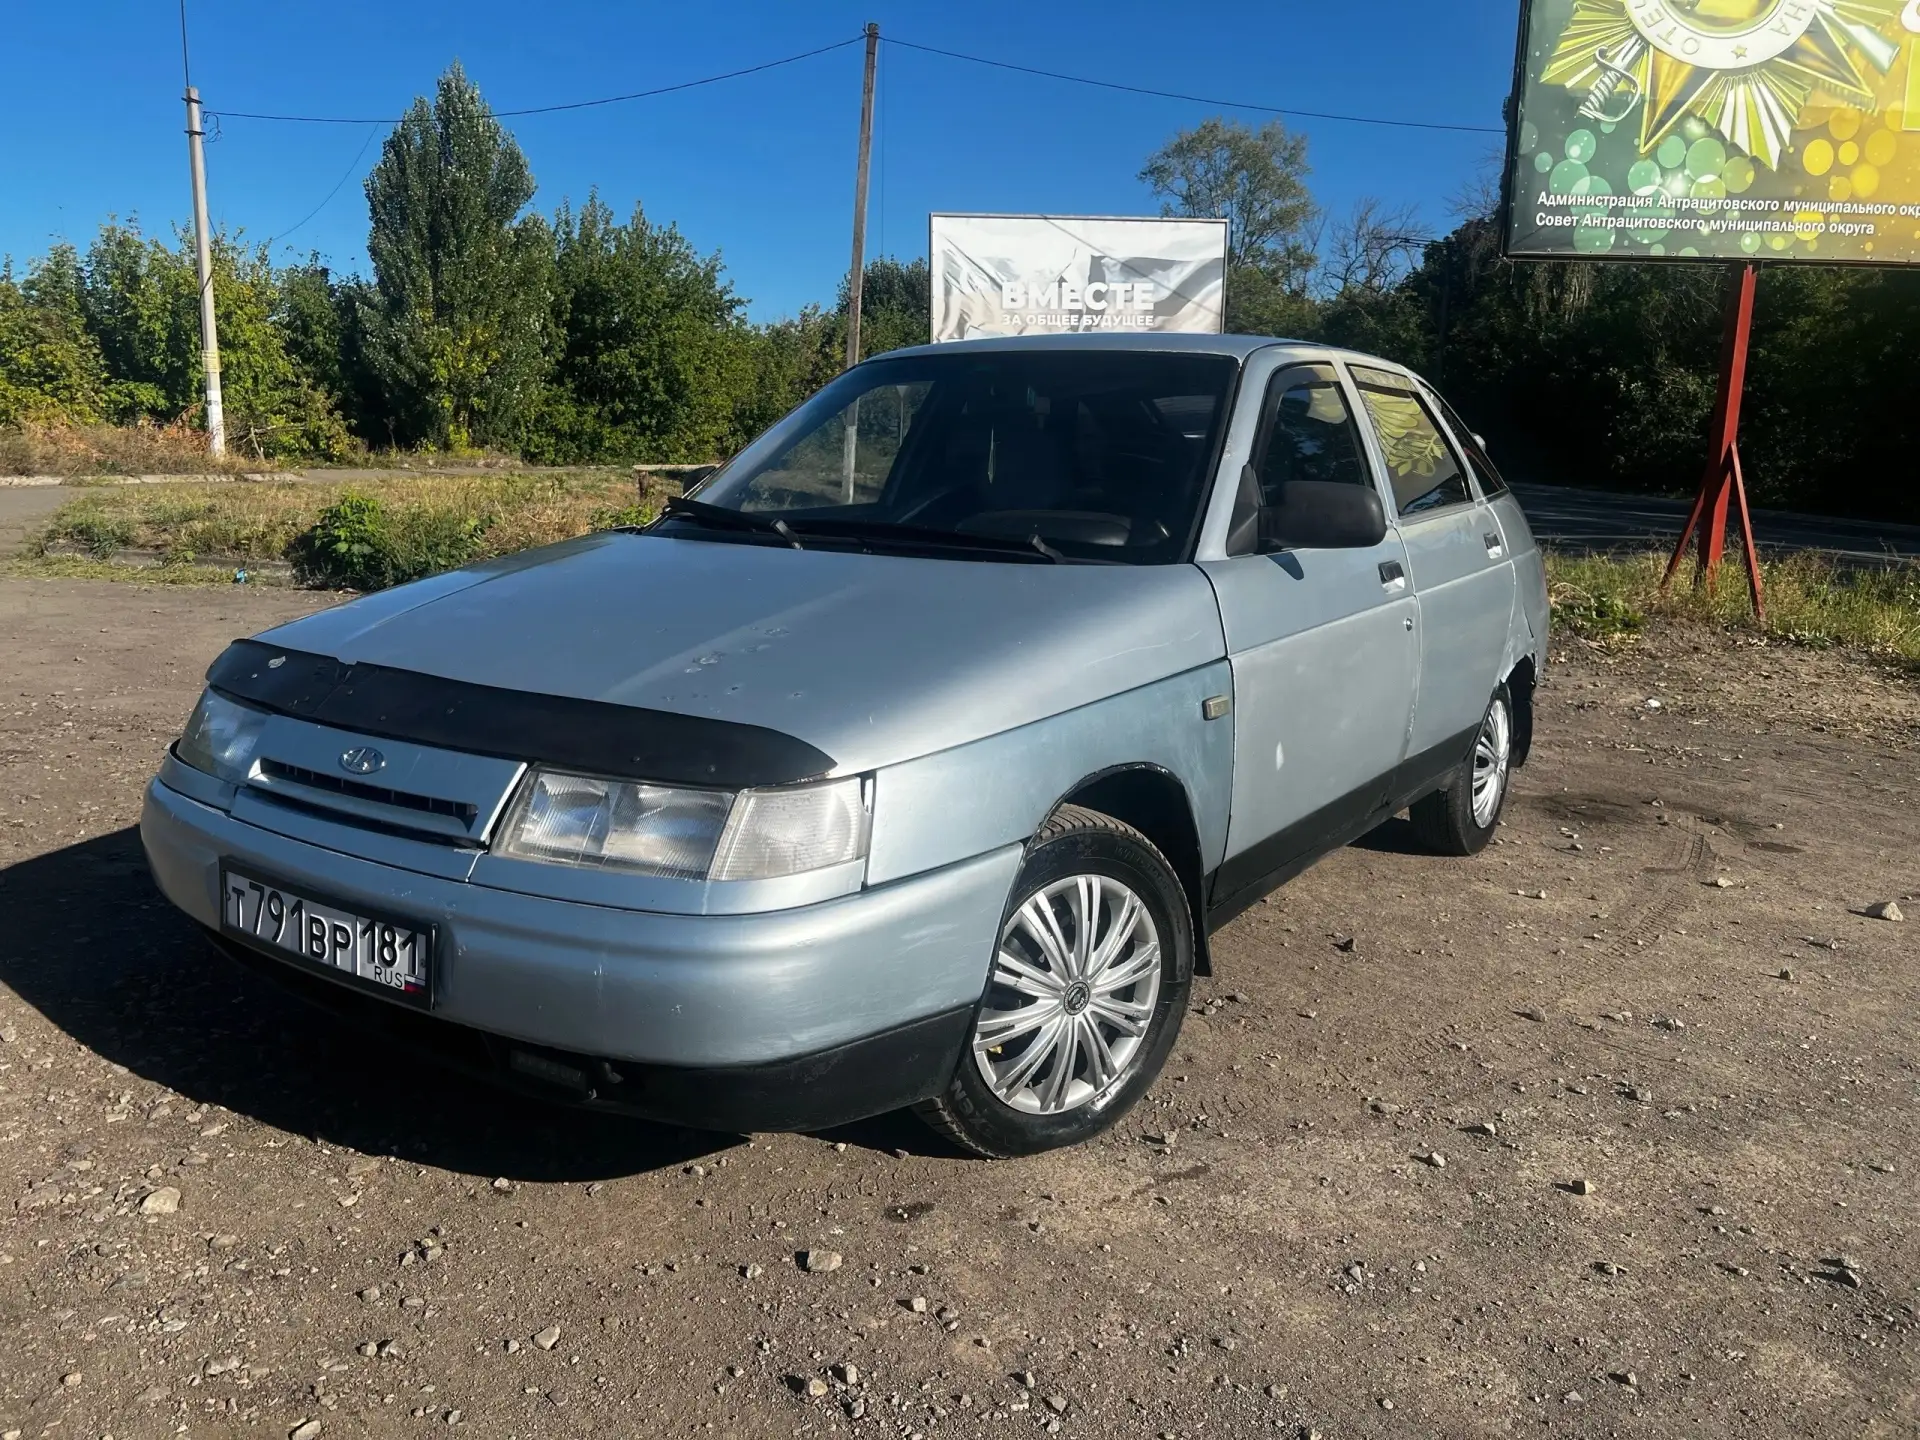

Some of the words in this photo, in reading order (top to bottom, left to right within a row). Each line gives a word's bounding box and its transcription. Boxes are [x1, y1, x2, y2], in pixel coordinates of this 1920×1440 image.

[1537, 191, 1653, 209] Администрация
[1657, 193, 1780, 211] Антрацитовского
[1783, 200, 1896, 216] муниципального
[1535, 212, 1579, 227] Совет
[1581, 213, 1705, 230] Антрацитовского
[1709, 218, 1825, 233] муниципального
[1829, 222, 1875, 236] округа
[1001, 281, 1155, 311] ВМЕСТЕ
[1002, 314, 1022, 326] ЗА
[1026, 314, 1079, 328] ОБЩЕЕ
[1083, 314, 1154, 329] БУДУЩЕЕ
[360, 917, 419, 976] 181
[373, 965, 404, 989] RUS
